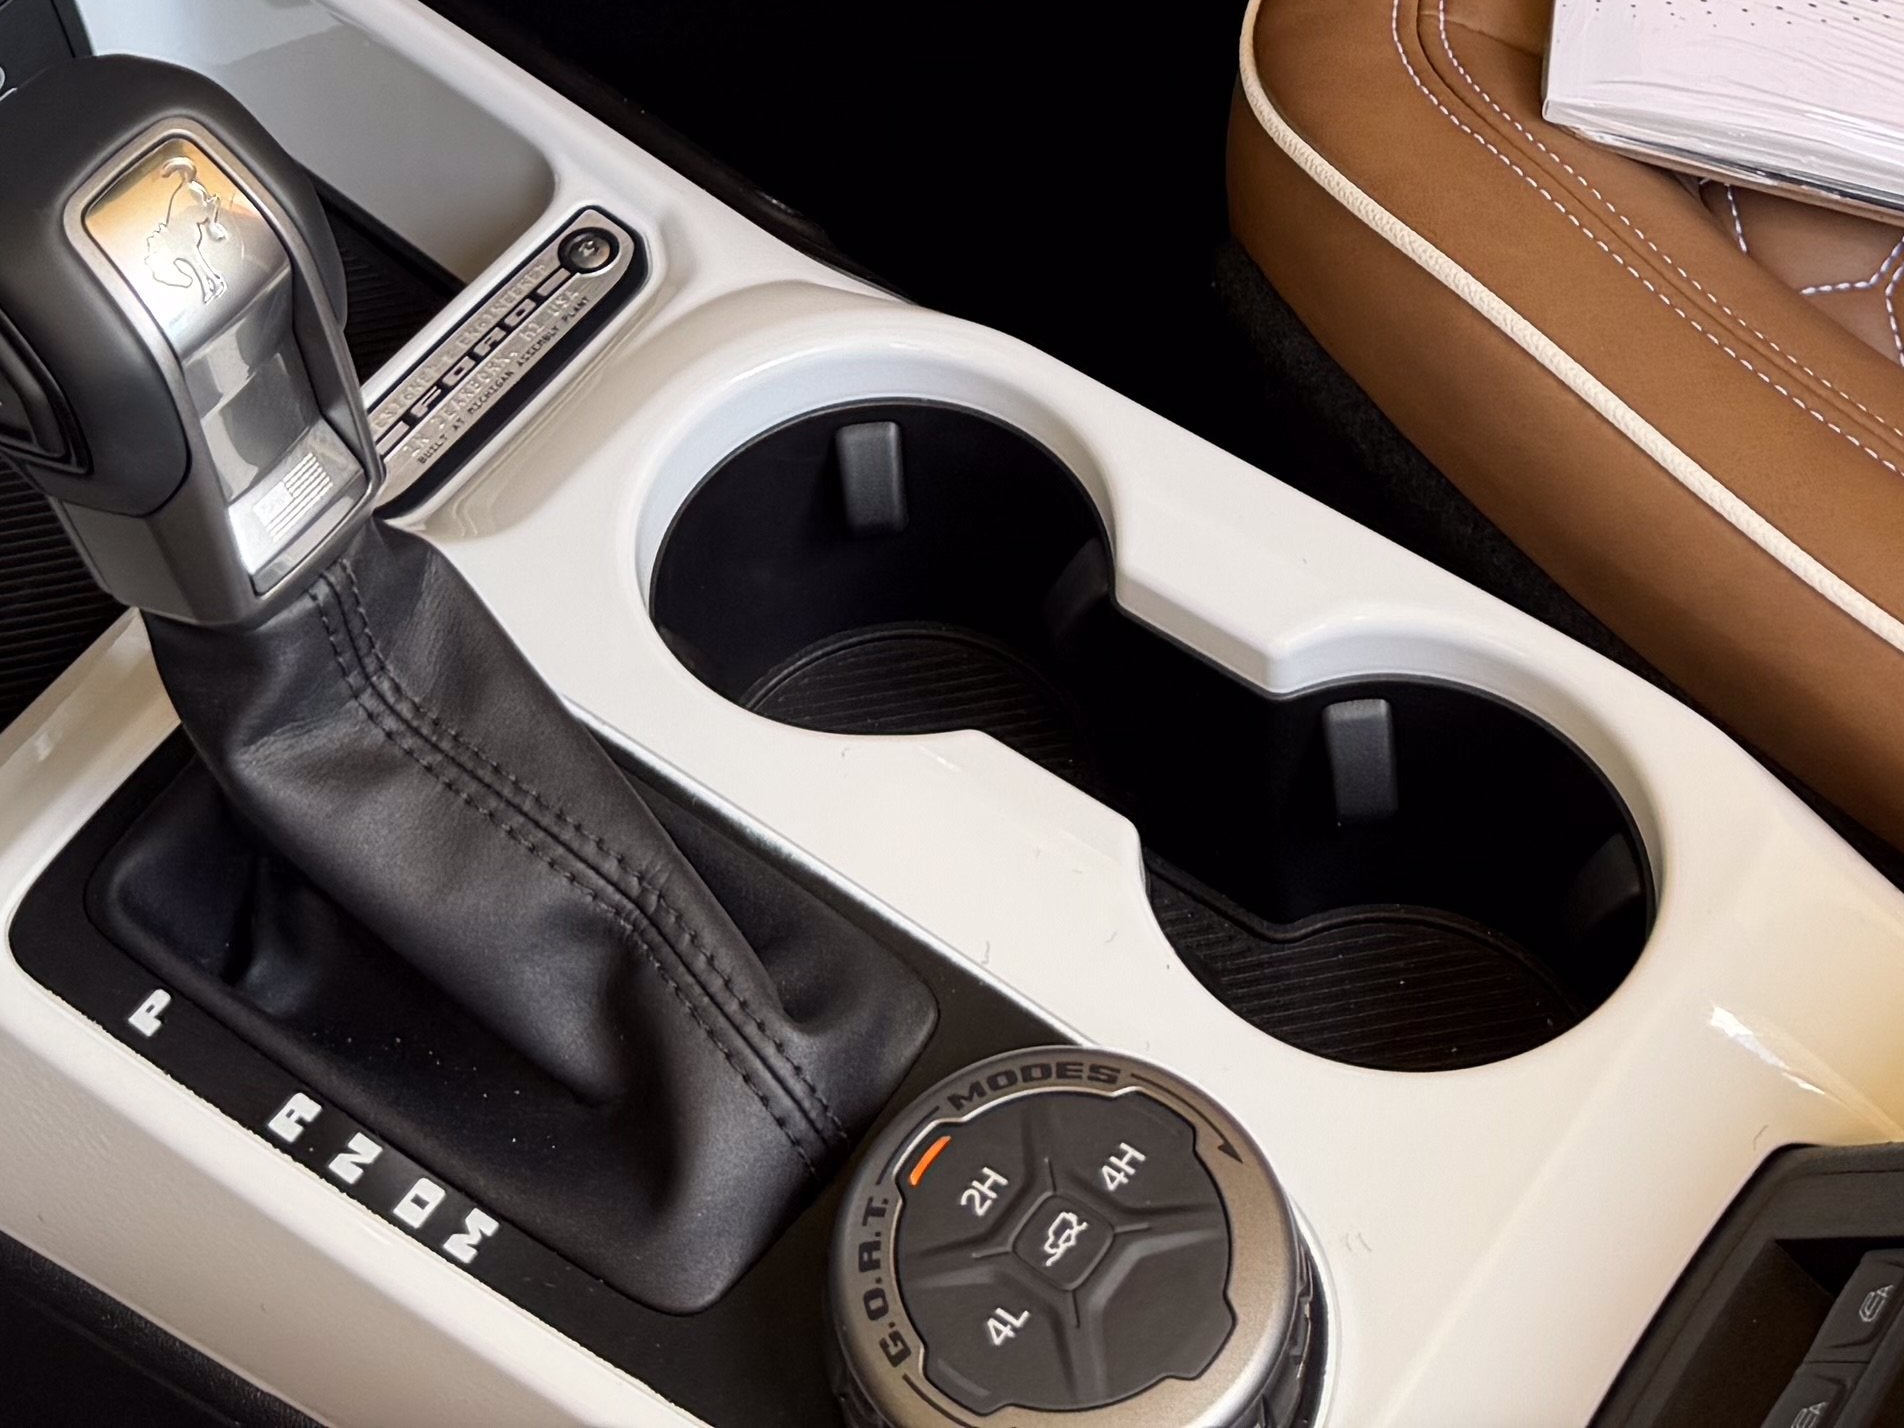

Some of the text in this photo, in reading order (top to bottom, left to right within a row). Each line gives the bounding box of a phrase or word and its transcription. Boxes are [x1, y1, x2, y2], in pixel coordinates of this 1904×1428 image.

[410, 298, 537, 418] FORD
[418, 296, 590, 464] BUILT AT MICHIGAN ASSEMBLY PLANT
[947, 1060, 1122, 1113] MODES
[127, 988, 502, 1265] P R N D M
[959, 1165, 1010, 1218] 2H
[1099, 1142, 1147, 1193] 4H
[985, 1306, 1031, 1347] 4L
